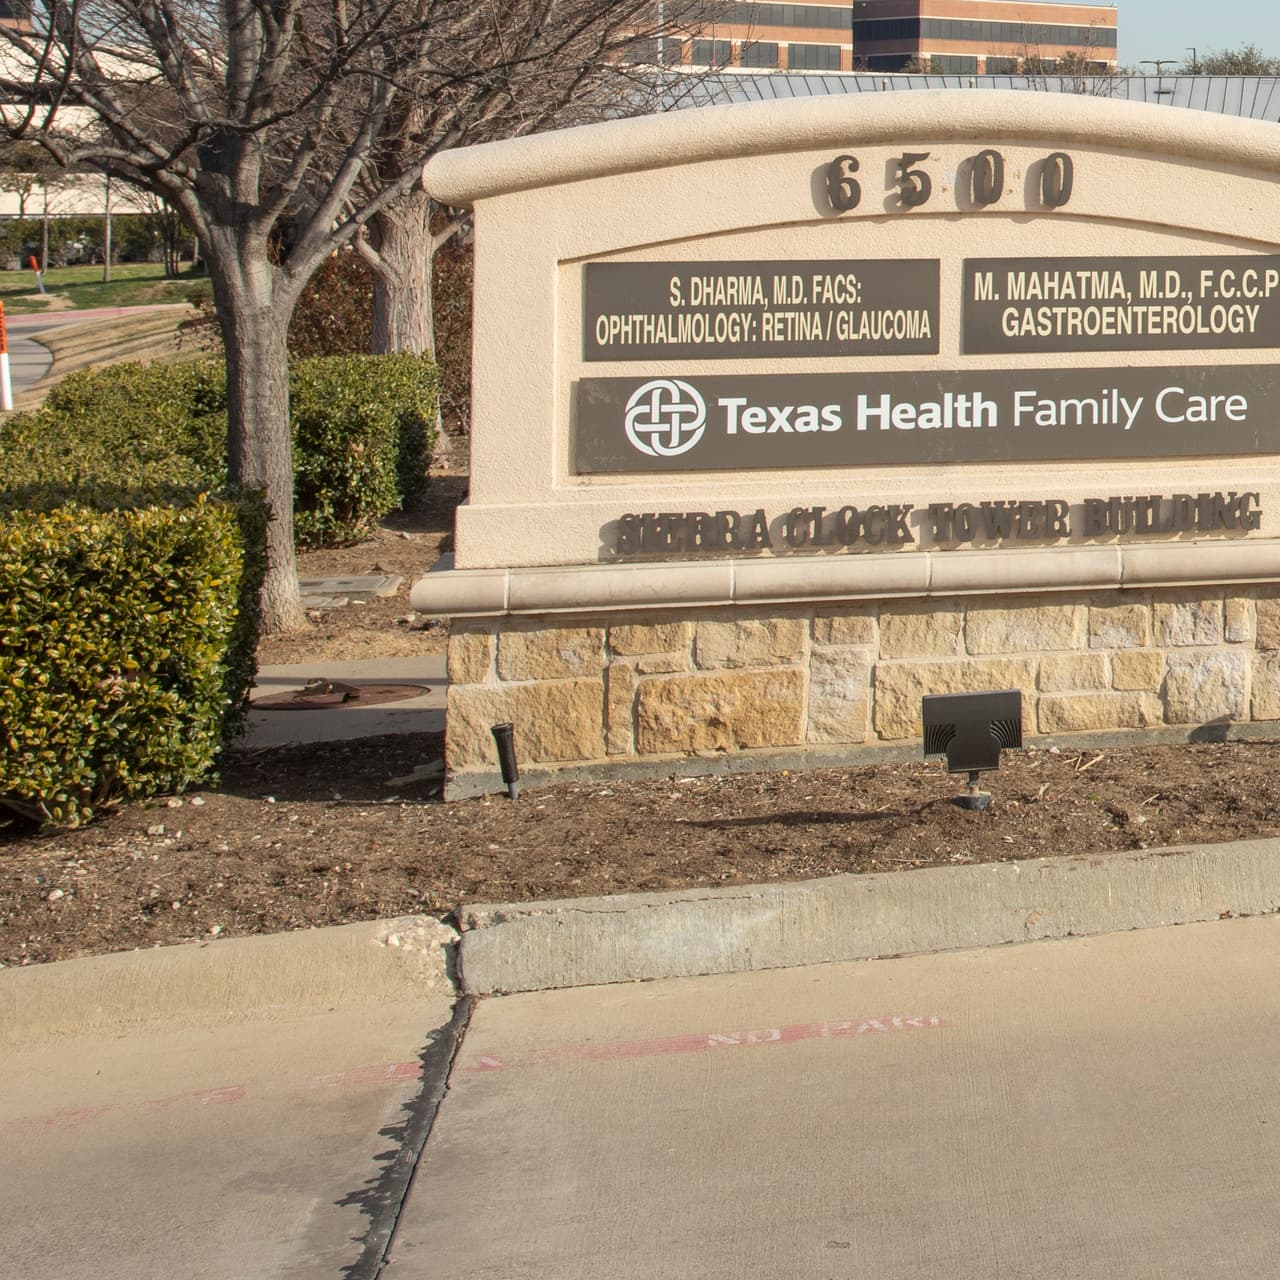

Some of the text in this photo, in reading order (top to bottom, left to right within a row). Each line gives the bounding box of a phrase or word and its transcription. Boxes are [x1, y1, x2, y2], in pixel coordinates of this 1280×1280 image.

[828, 149, 1075, 211] 6500
[670, 274, 862, 310] S. DHARMA, M.D. FACS:
[974, 272, 1000, 301] M.
[1007, 270, 1133, 304] MAHATMA,
[1139, 270, 1193, 303] M.D.,
[596, 312, 757, 346] OPHTHALMOLOGY:
[762, 311, 823, 342] RETINA
[836, 310, 932, 341] GLAUCOMA
[1002, 304, 1260, 337] GASTROENTEROLOGY
[718, 386, 1249, 435] Texas Health Family Care
[617, 491, 1263, 554] SIERRA CLOCK TOWER BUILDING
